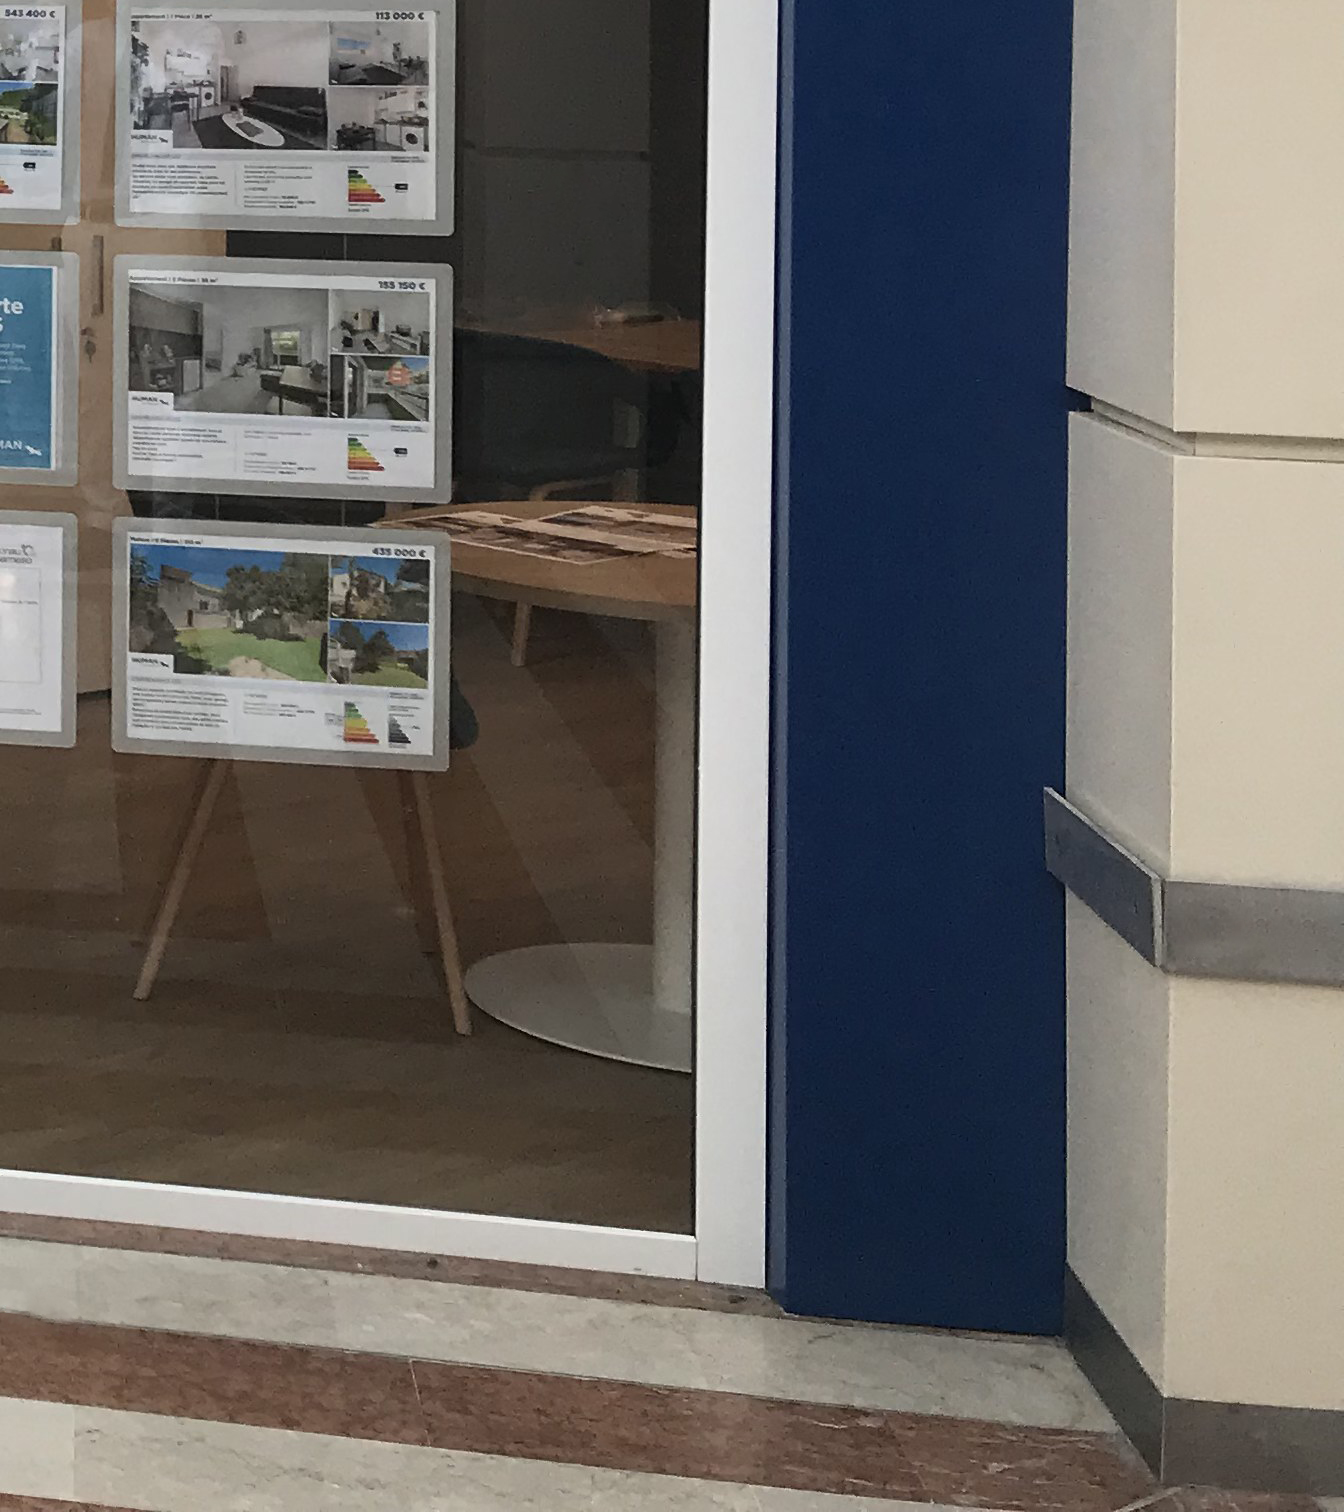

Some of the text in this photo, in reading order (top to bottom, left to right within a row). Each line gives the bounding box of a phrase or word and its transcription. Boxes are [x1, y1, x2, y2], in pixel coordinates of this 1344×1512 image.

[5, 9, 24, 18] 543
[26, 9, 47, 18] 400
[375, 11, 391, 20] 113
[393, 11, 416, 20] 000
[394, 548, 417, 558] 000
